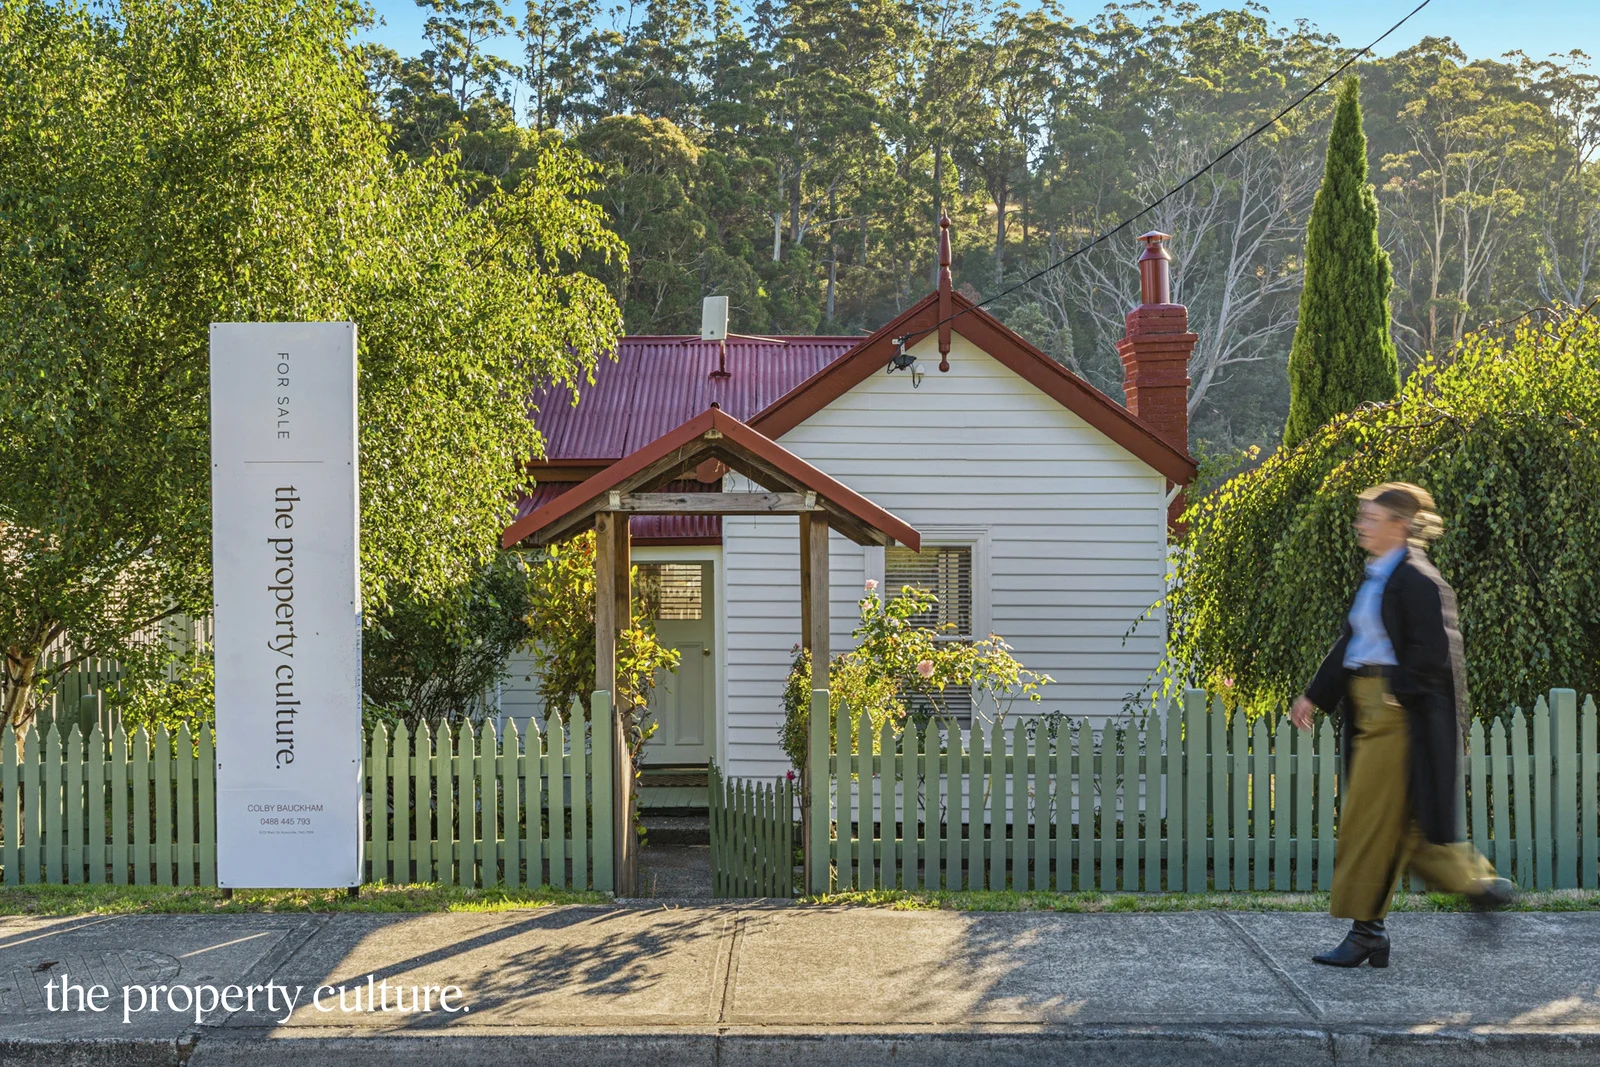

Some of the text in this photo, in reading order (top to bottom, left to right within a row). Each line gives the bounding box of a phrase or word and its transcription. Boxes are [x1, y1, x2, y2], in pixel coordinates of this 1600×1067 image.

[276, 352, 290, 440] FOR SALE
[266, 484, 302, 770] the property culture.
[247, 804, 324, 812] COLBY BAUCKHAM
[260, 817, 311, 825] 0488 445 793
